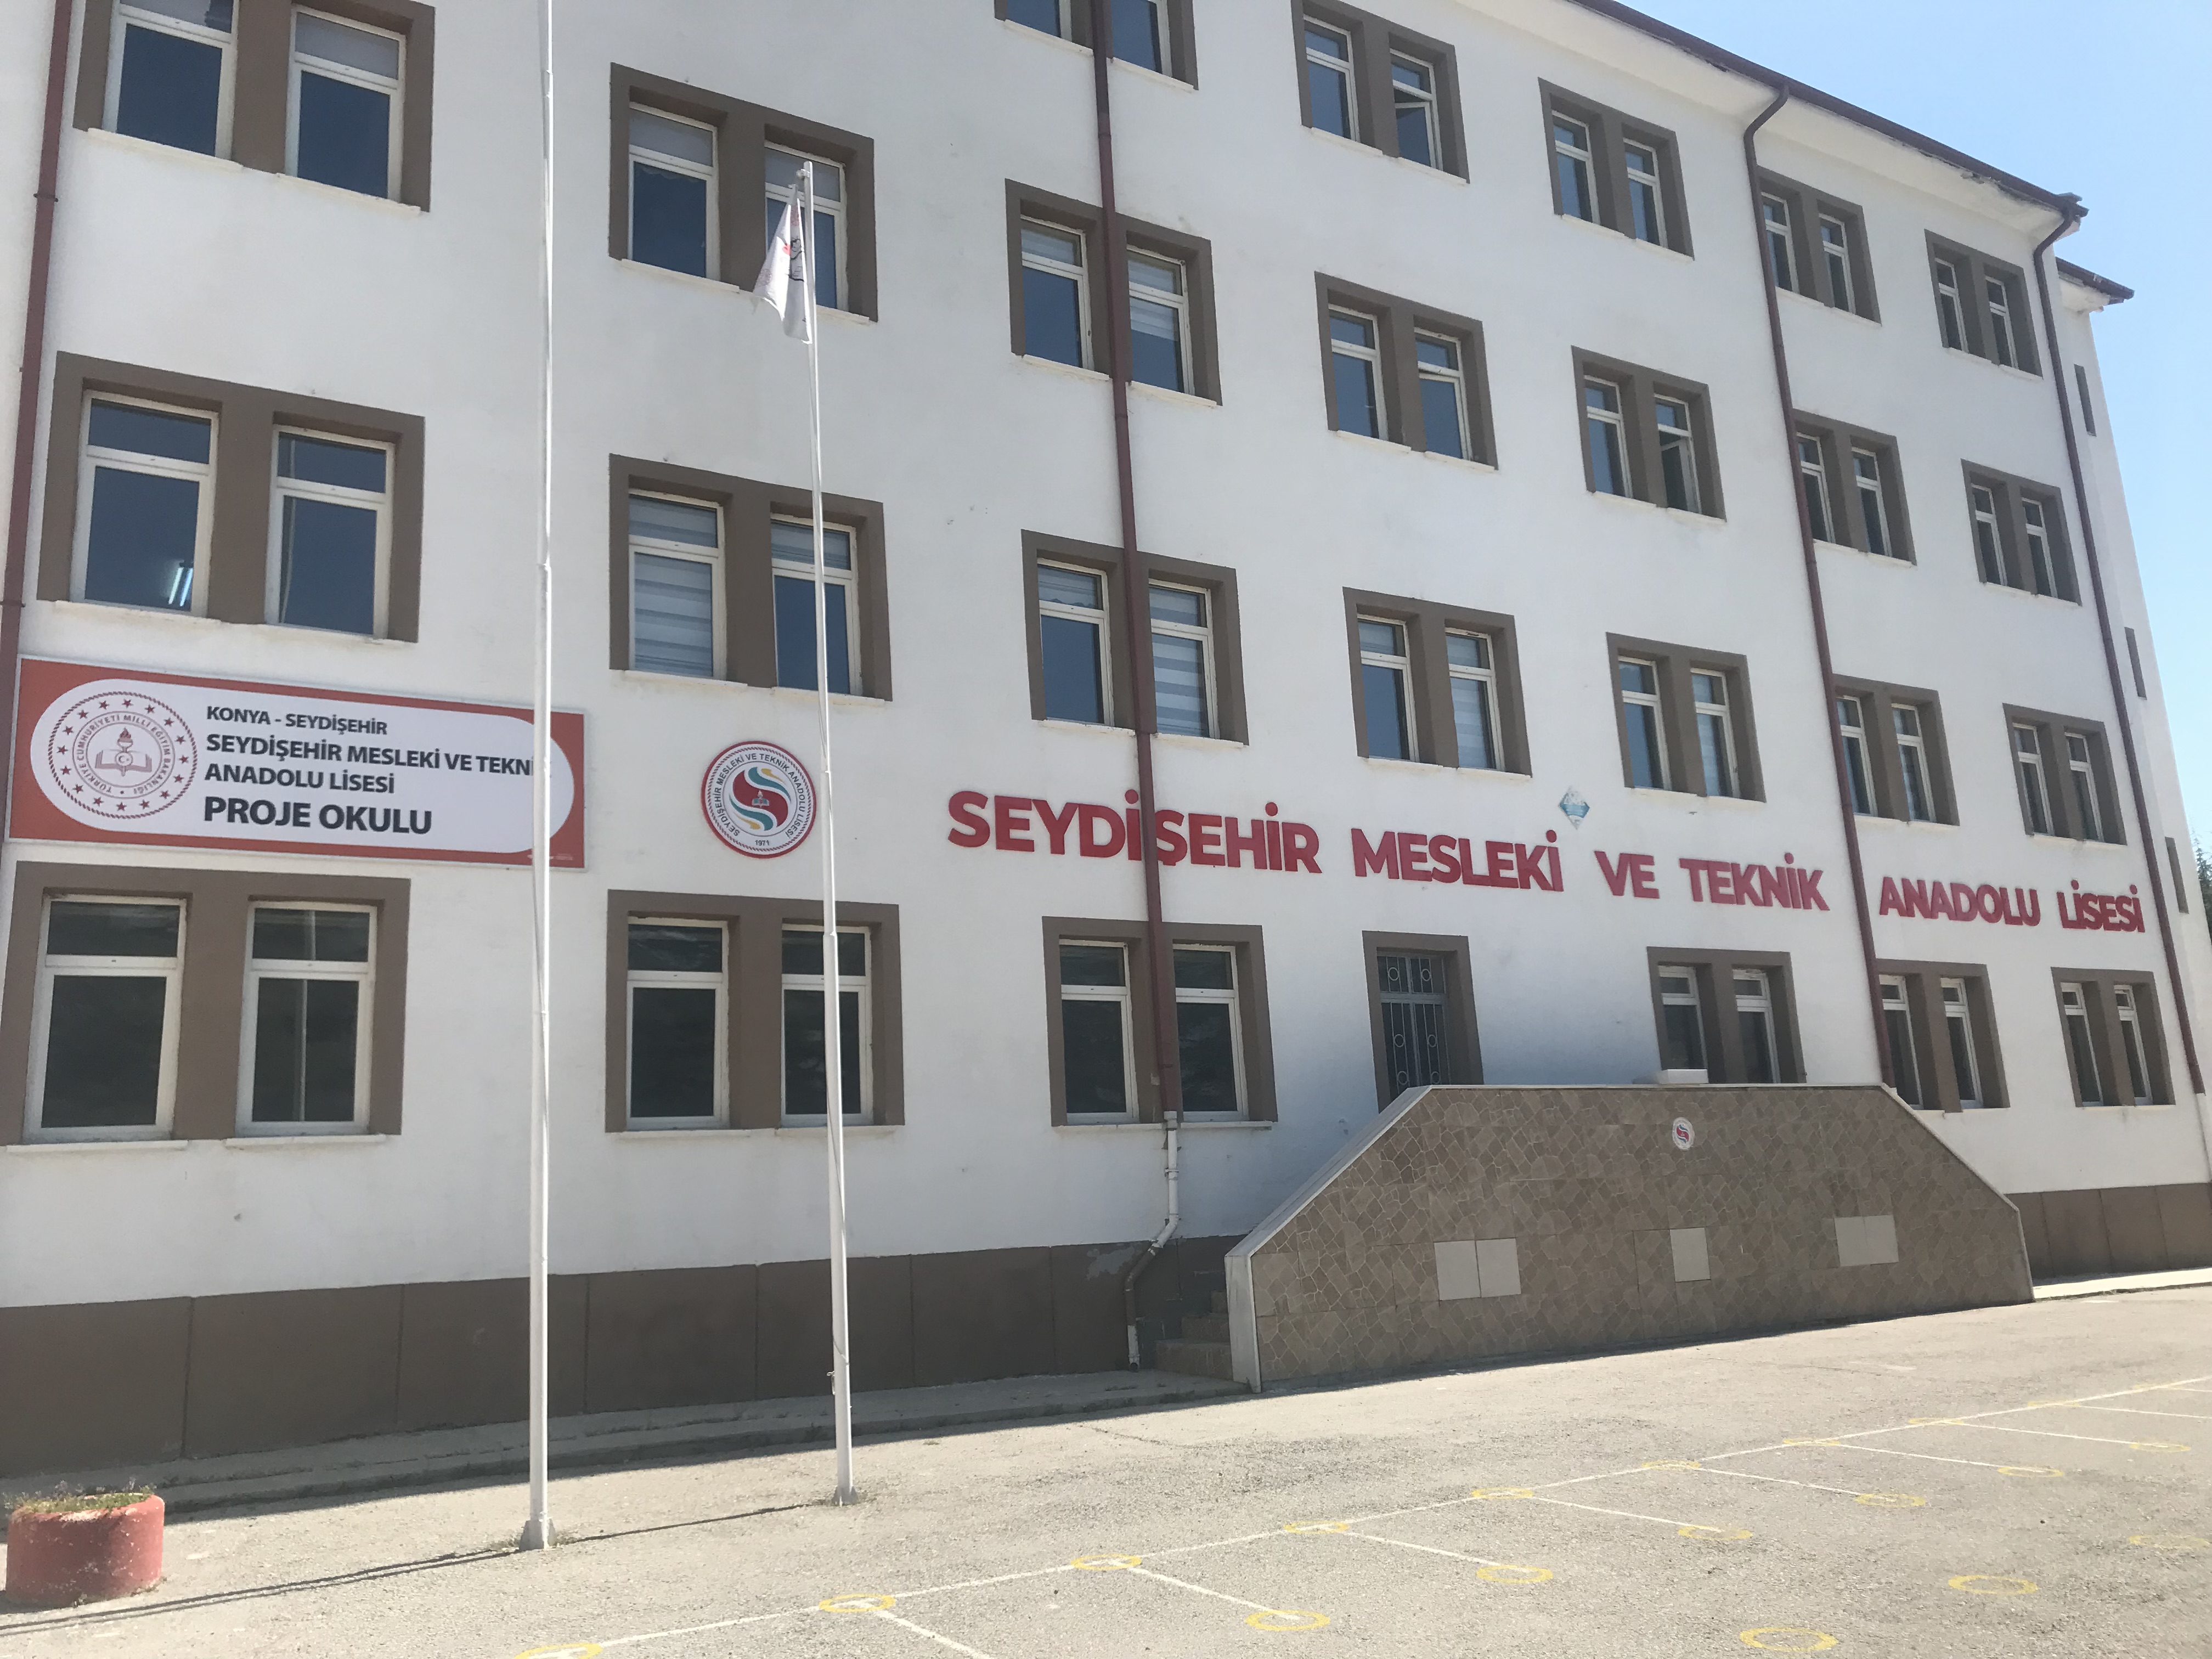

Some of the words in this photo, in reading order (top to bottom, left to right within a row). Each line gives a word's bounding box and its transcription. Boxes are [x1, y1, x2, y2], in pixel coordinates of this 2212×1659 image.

[206, 706, 271, 725] KONYA
[285, 713, 387, 735] SEYDİŞEHİR
[207, 733, 342, 761] SEYDİŞEHİR
[347, 746, 440, 769] MESLEKİ
[444, 753, 472, 771] VE
[759, 753, 790, 772] TEKNİK
[205, 763, 324, 788] ANADOLU
[329, 769, 394, 794] LİSESİ
[716, 754, 744, 786] MESLEKİ
[788, 771, 806, 812] ANADOLU
[204, 796, 312, 828] PROJE
[319, 804, 432, 835] OKULU
[713, 787, 741, 837] SEYDİŞEHİR
[785, 812, 804, 839] LİSESİ
[947, 789, 1323, 874] SEYDİŞEHİR
[1351, 829, 1564, 892] MESLEKİ
[1594, 850, 1660, 899] VE
[1679, 853, 1831, 911] TEKNİK
[1880, 877, 2041, 927] ANADOLU
[2056, 879, 2146, 933] LİSESİ
